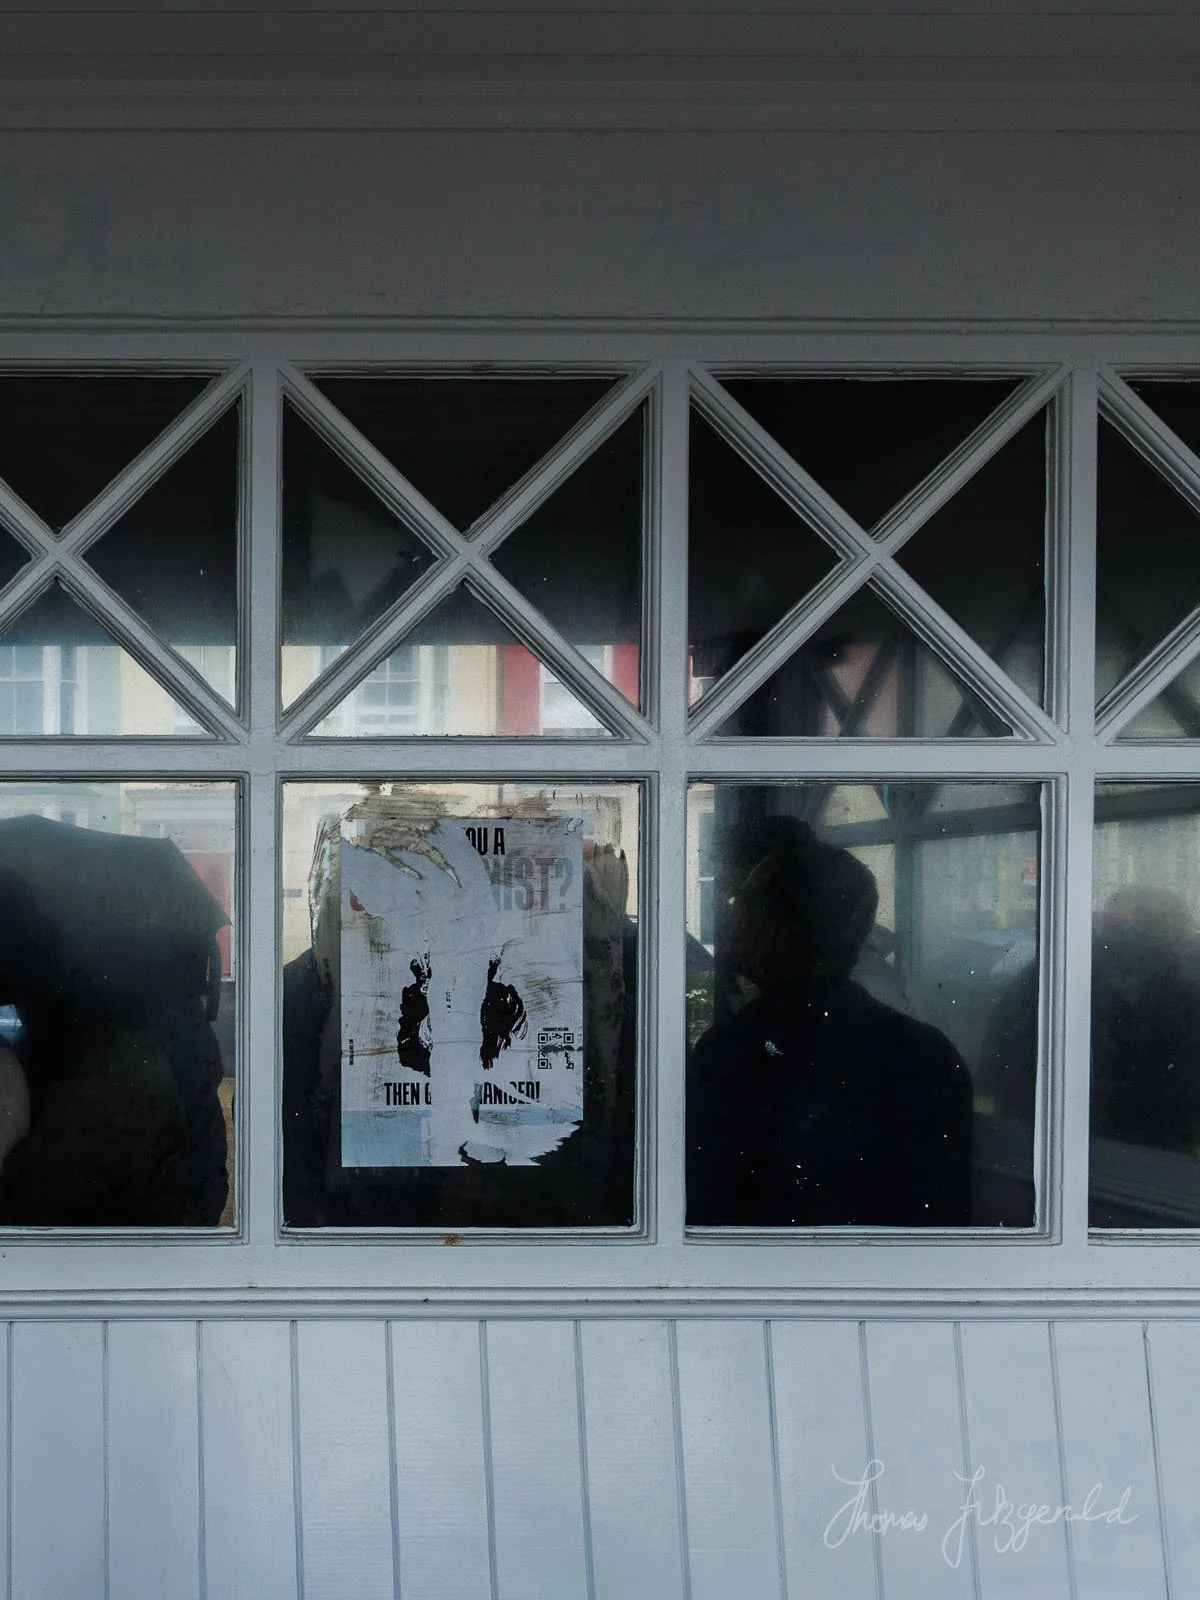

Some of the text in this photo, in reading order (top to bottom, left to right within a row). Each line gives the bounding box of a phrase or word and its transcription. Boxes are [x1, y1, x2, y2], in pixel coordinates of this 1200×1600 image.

[465, 827, 505, 855] OU A
[384, 1083, 419, 1105] THEN
